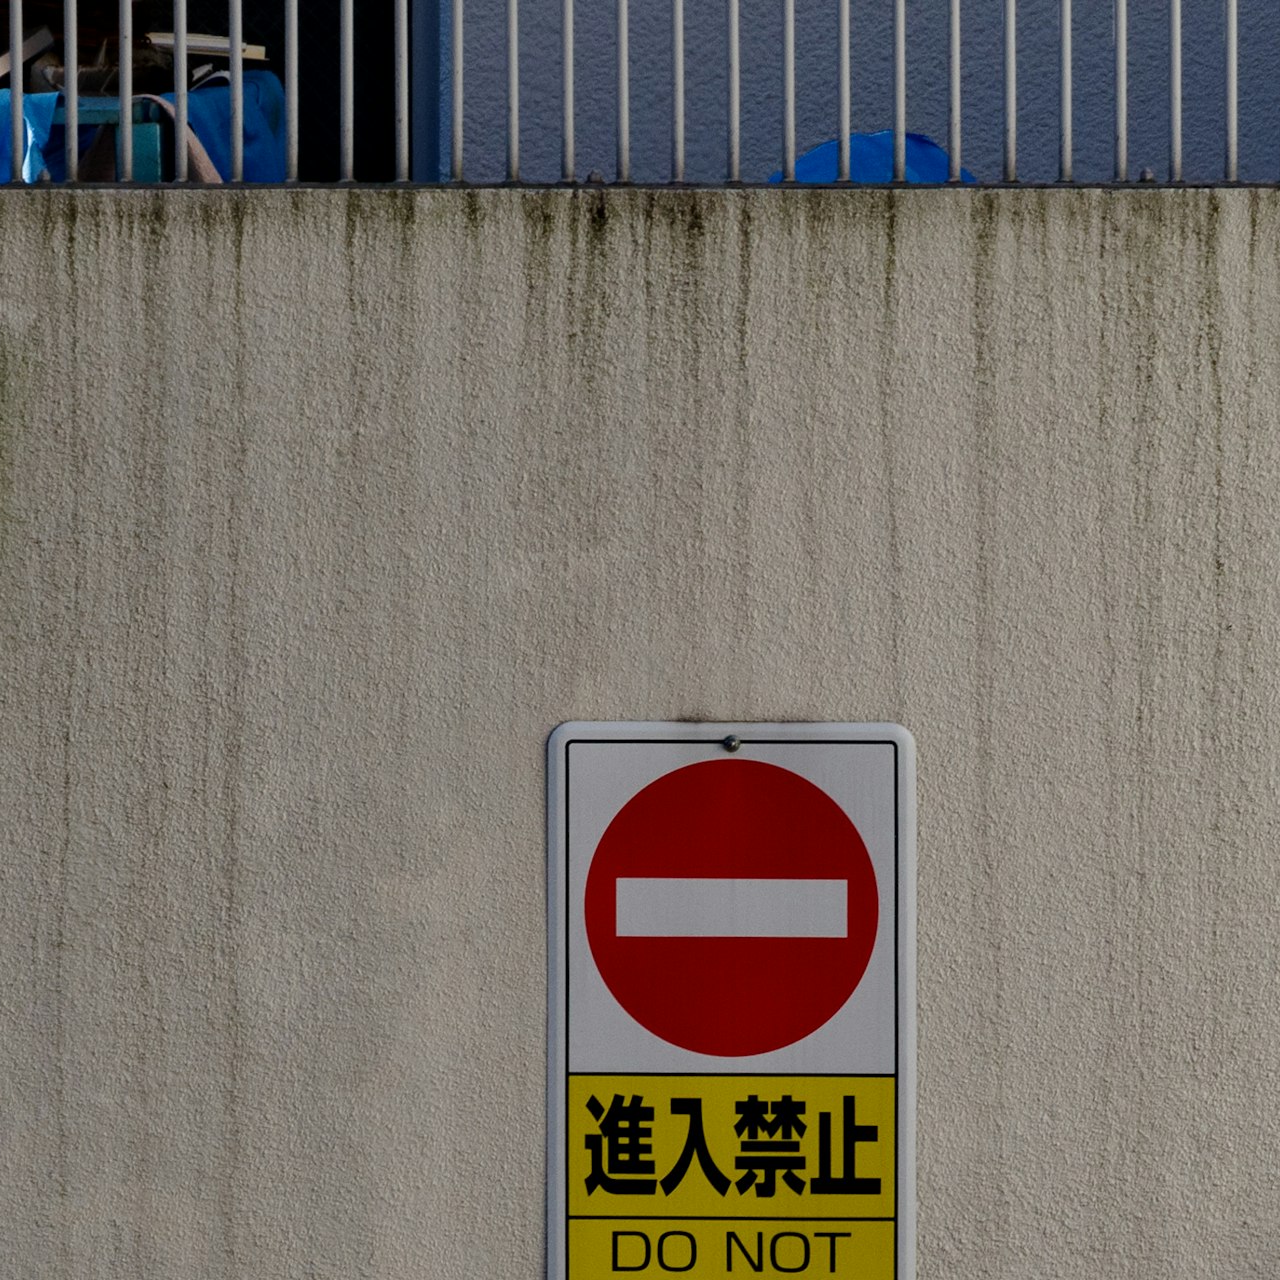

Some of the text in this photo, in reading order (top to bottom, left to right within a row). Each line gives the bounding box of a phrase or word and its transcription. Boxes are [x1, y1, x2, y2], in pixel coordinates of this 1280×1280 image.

[584, 1093, 882, 1198] 進入禁止
[611, 1230, 852, 1273] DO NOT
